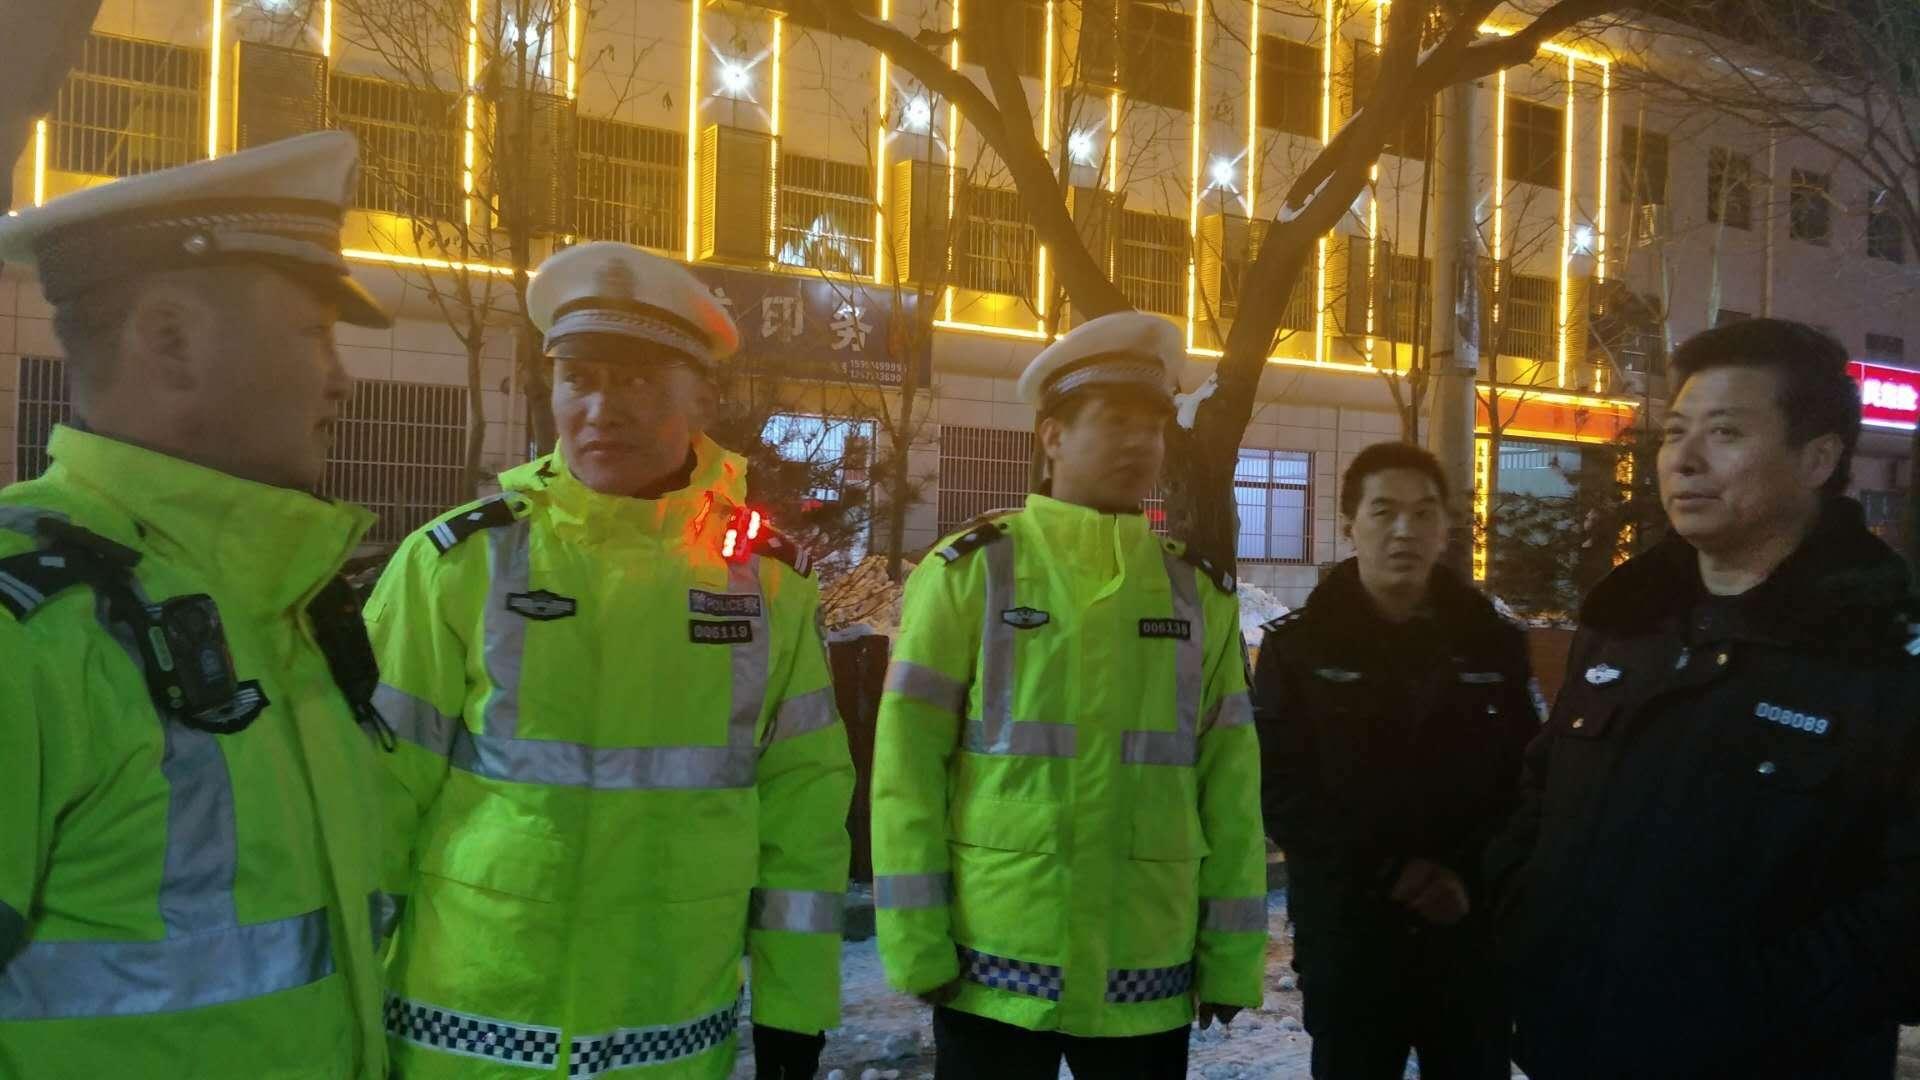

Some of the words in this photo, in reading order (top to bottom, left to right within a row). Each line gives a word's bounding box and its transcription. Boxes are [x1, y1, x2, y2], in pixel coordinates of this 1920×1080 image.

[706, 597, 744, 612] POLICE
[694, 624, 748, 639] 006119
[1755, 701, 1829, 734] 008089
